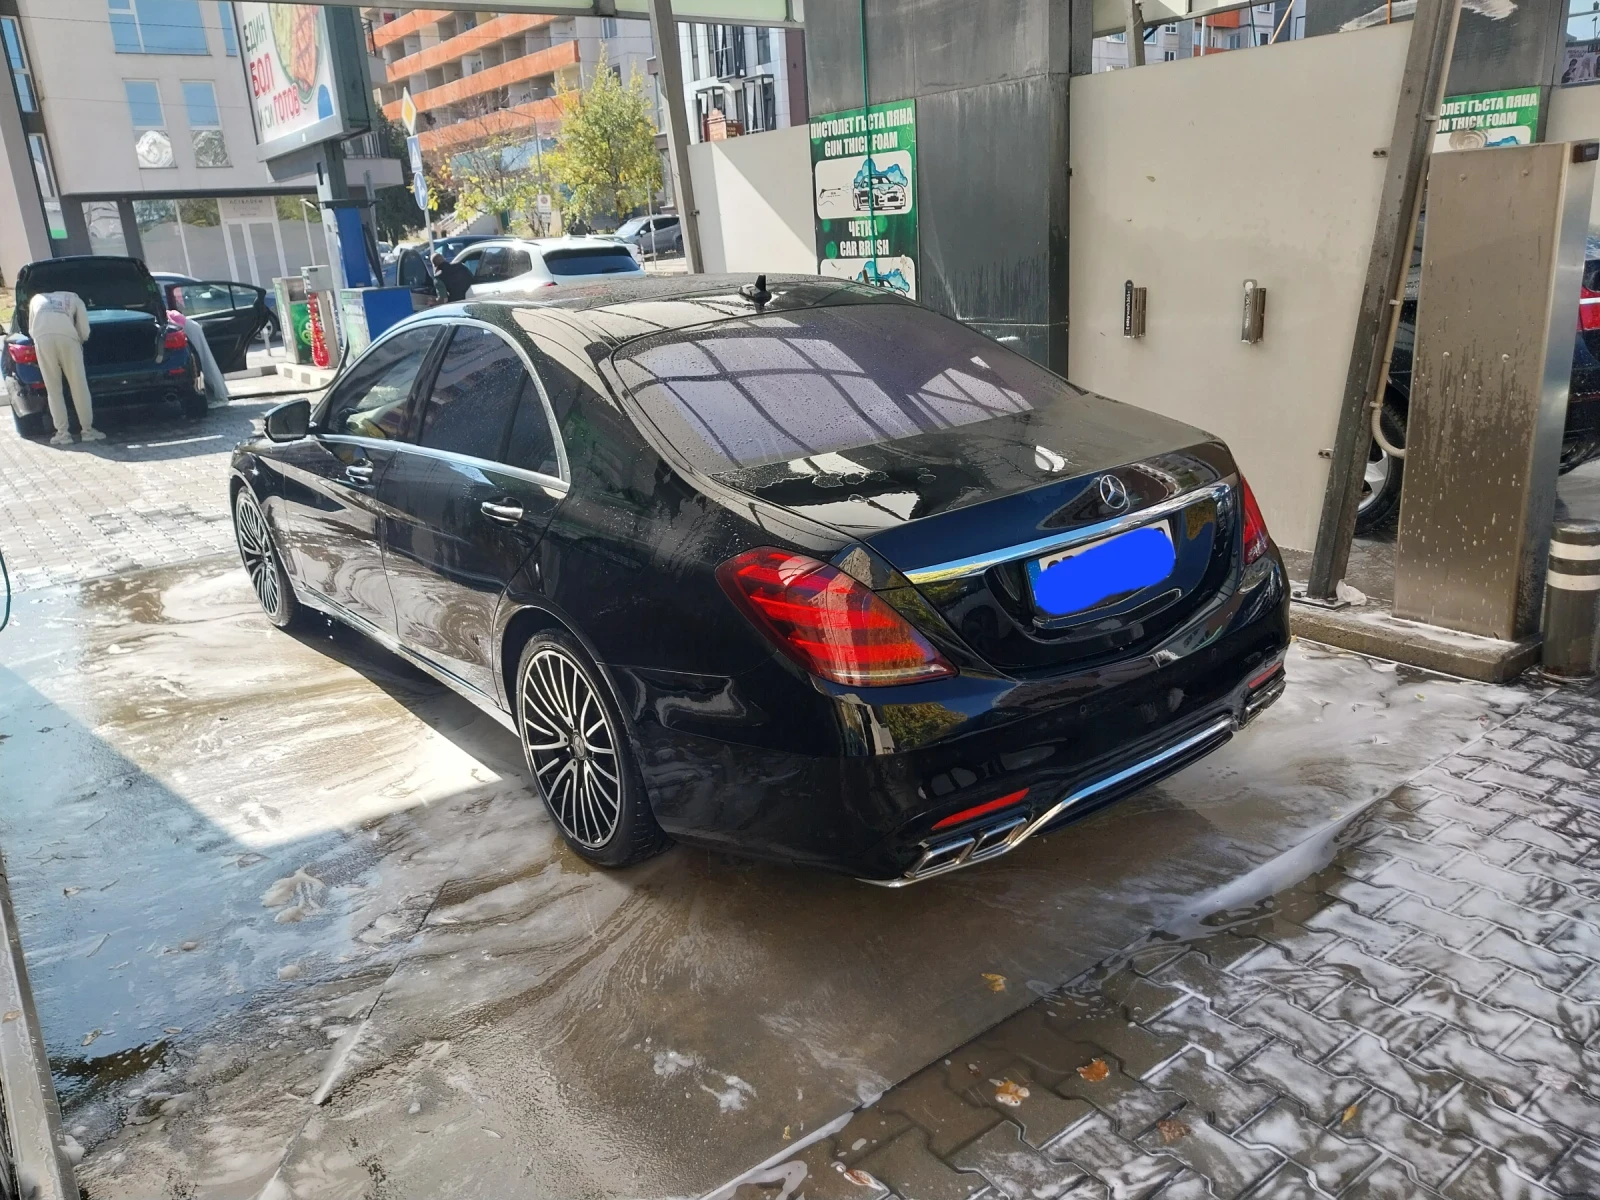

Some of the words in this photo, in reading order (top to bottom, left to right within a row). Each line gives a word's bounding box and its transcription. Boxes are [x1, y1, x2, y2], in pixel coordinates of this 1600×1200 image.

[243, 13, 268, 55] ЕДИН
[249, 52, 275, 99] БОЛ
[273, 83, 301, 126] ГОТОВ
[1439, 101, 1467, 117] ОЛЕТ
[1468, 97, 1503, 113] ГЪСТА
[1505, 93, 1537, 109] ПЯНА
[811, 117, 854, 139] ПИСТОЛЕТ
[887, 107, 913, 127] ПЯНА
[1436, 118, 1450, 132] UN
[1451, 115, 1484, 130] THICK
[1486, 111, 1517, 126] FOAM
[824, 139, 843, 157] GUN
[872, 131, 898, 150] FOAM
[840, 240, 858, 257] CAR
